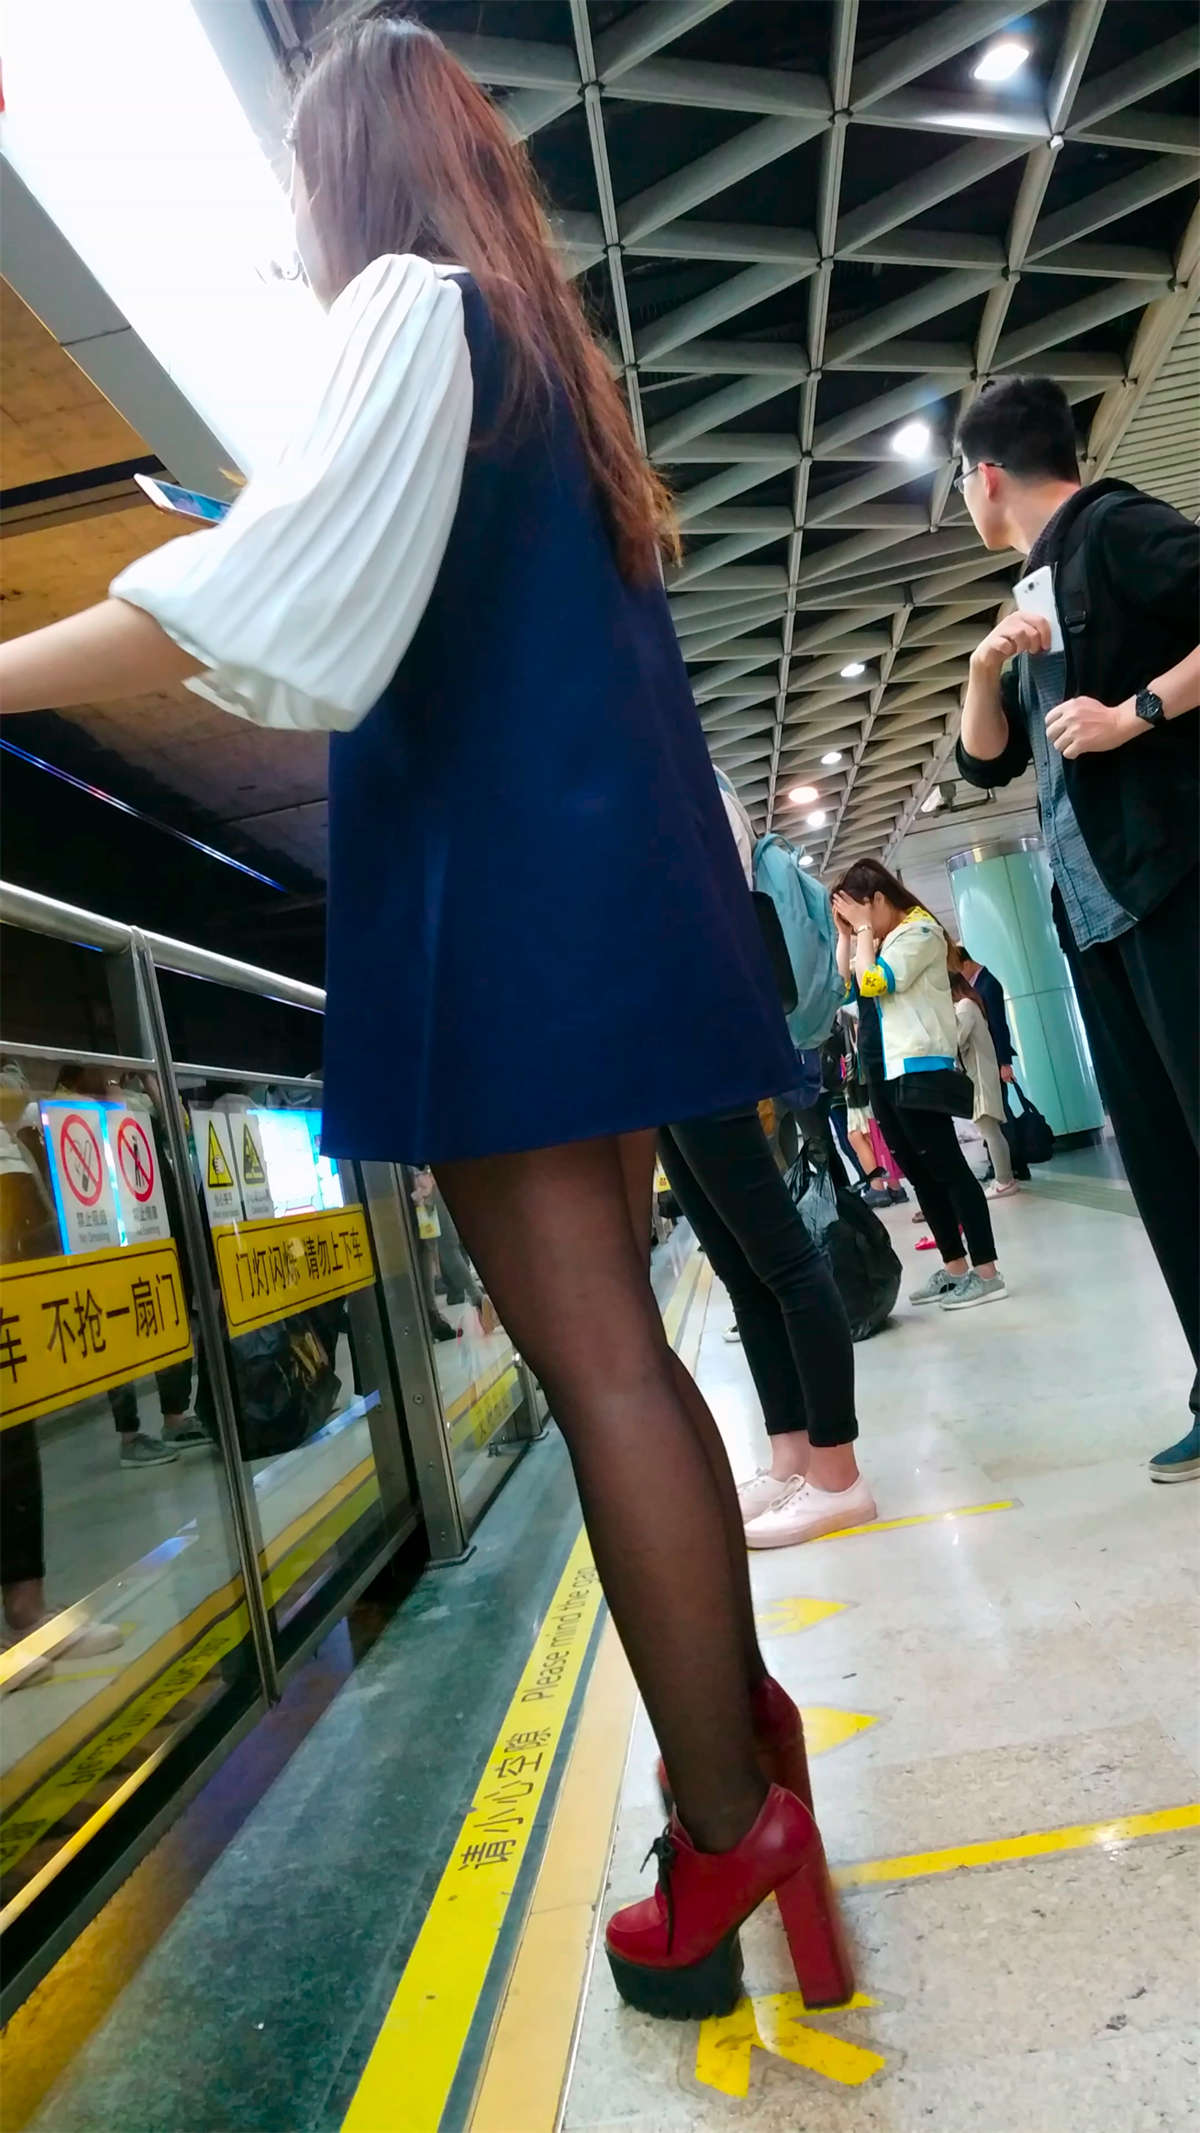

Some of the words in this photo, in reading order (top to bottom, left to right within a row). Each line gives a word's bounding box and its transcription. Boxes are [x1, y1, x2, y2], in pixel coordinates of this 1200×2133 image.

[303, 1228, 363, 1280] 请勿上下车
[41, 1272, 181, 1365] 不抢一扇门
[555, 1589, 589, 1612] the
[545, 1612, 582, 1648] mind
[520, 1650, 570, 1703] Please
[457, 1727, 552, 1872] 请小心空隙
